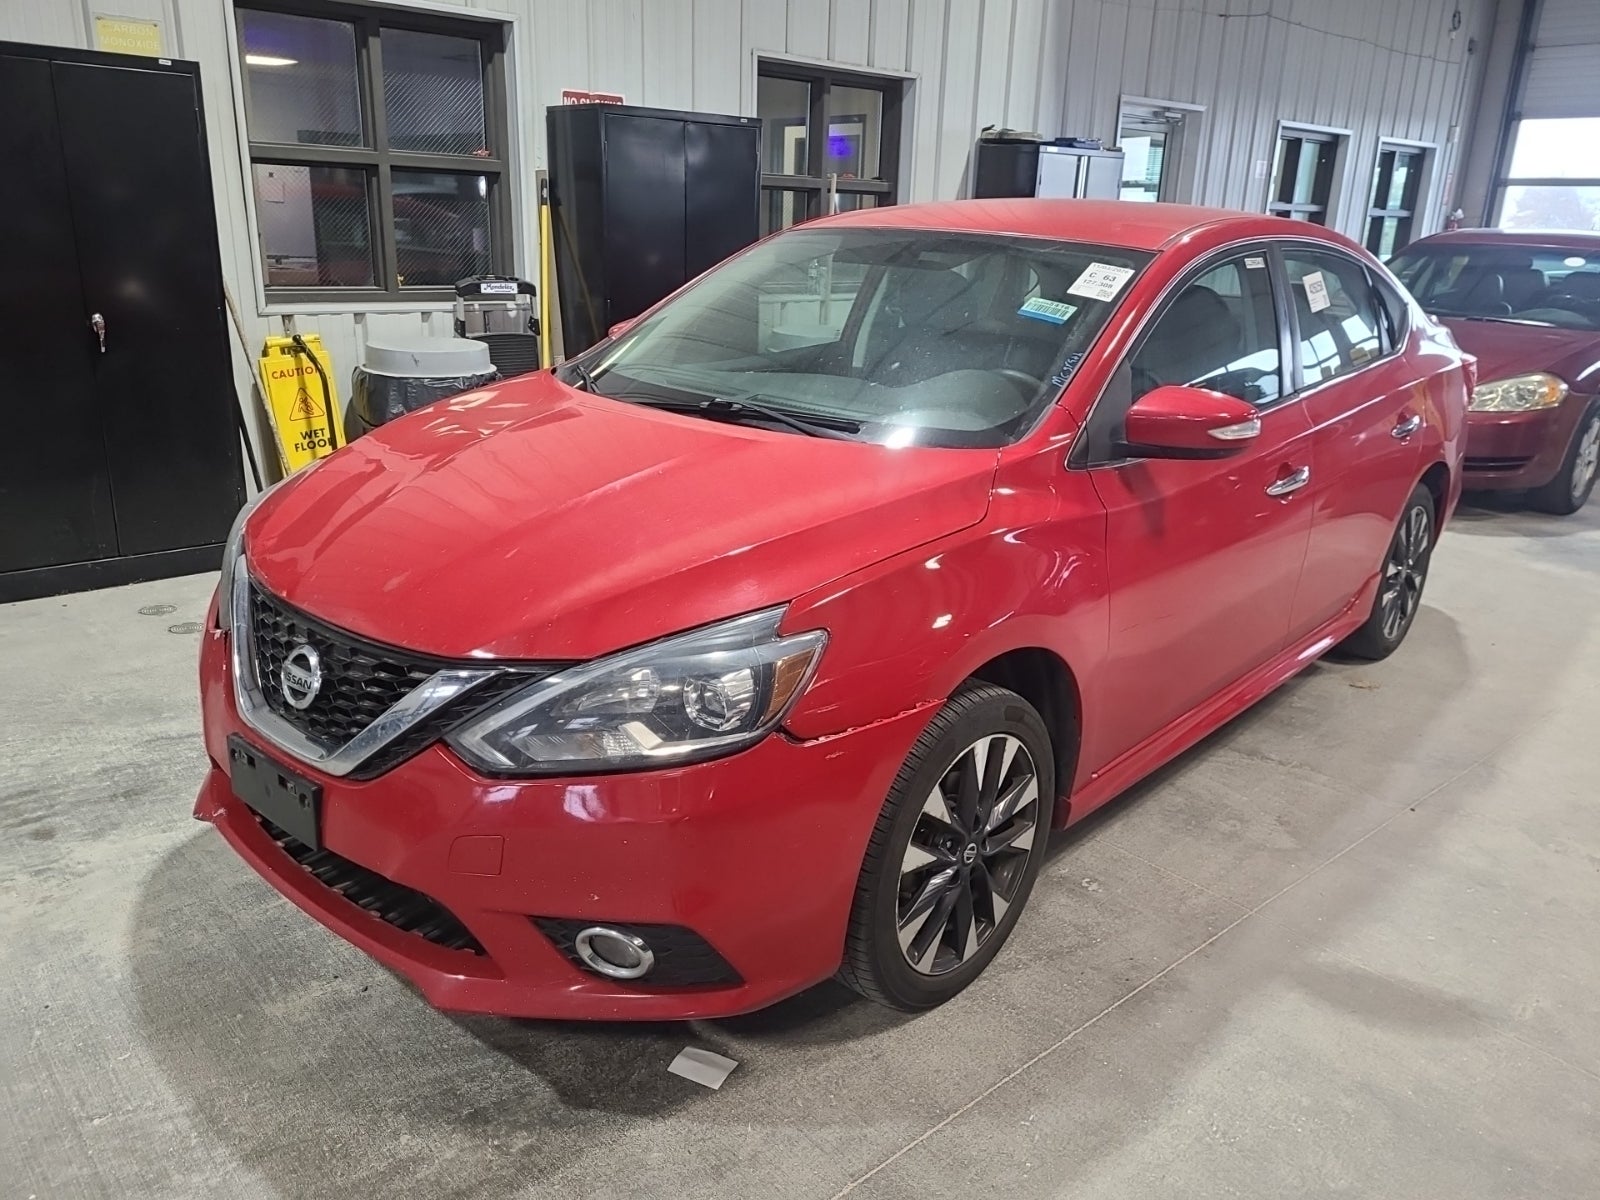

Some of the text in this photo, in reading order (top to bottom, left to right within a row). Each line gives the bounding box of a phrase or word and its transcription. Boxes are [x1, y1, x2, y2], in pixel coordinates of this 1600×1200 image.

[103, 24, 154, 36] ARBON
[1103, 274, 1117, 282] 63
[299, 428, 326, 440] WET
[284, 671, 312, 690] SSAN
